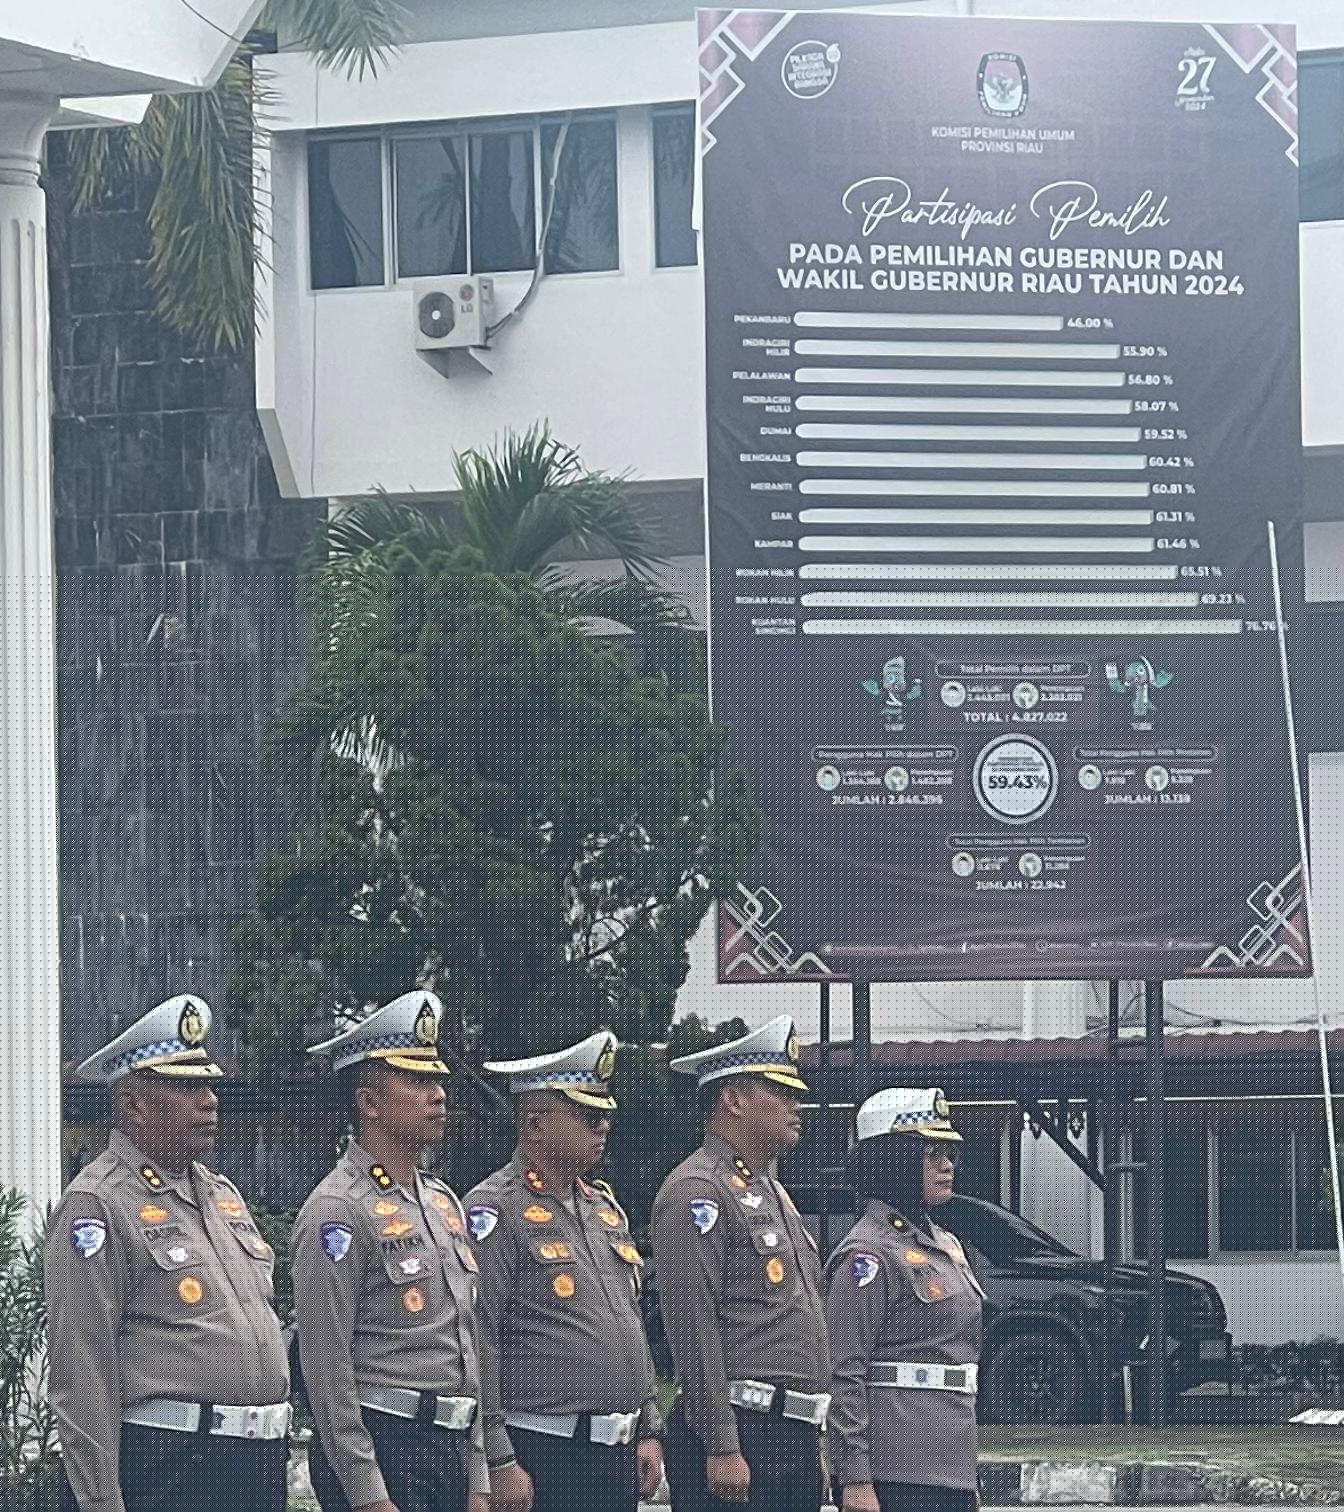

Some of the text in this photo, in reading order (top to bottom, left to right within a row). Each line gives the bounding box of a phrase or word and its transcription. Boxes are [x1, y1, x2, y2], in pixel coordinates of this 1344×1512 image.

[1177, 57, 1216, 94] 27
[931, 126, 1075, 141] KOMISI PEMILIHAN UMUM
[961, 140, 1044, 153] PROVINSI RIAU
[842, 176, 1170, 240] Partisipasi Pemilih
[789, 243, 1223, 270] PADA PEMILIHAN GUBERNUR DAN
[777, 267, 1244, 296] WAKIL GUBERNUR RIAU TAHUN 2024
[460, 303, 474, 313] LG
[1067, 317, 1101, 328] 46.00
[1123, 346, 1155, 357] 55.90
[732, 371, 791, 380] PELALAWAN
[1128, 374, 1160, 385] 56.80
[1134, 401, 1166, 412] 58.07
[1144, 429, 1175, 440] 59.52
[740, 452, 791, 462] BENGKALIS
[1149, 456, 1181, 467] 60.42
[1152, 483, 1183, 494] 60.81
[771, 511, 793, 520] SIAK
[963, 712, 1003, 722] TOTAL
[988, 775, 1048, 789] 59.43%
[831, 795, 879, 805] JUMLAH
[1104, 794, 1152, 804] JUMLAH
[976, 880, 1022, 890] JUMLAH
